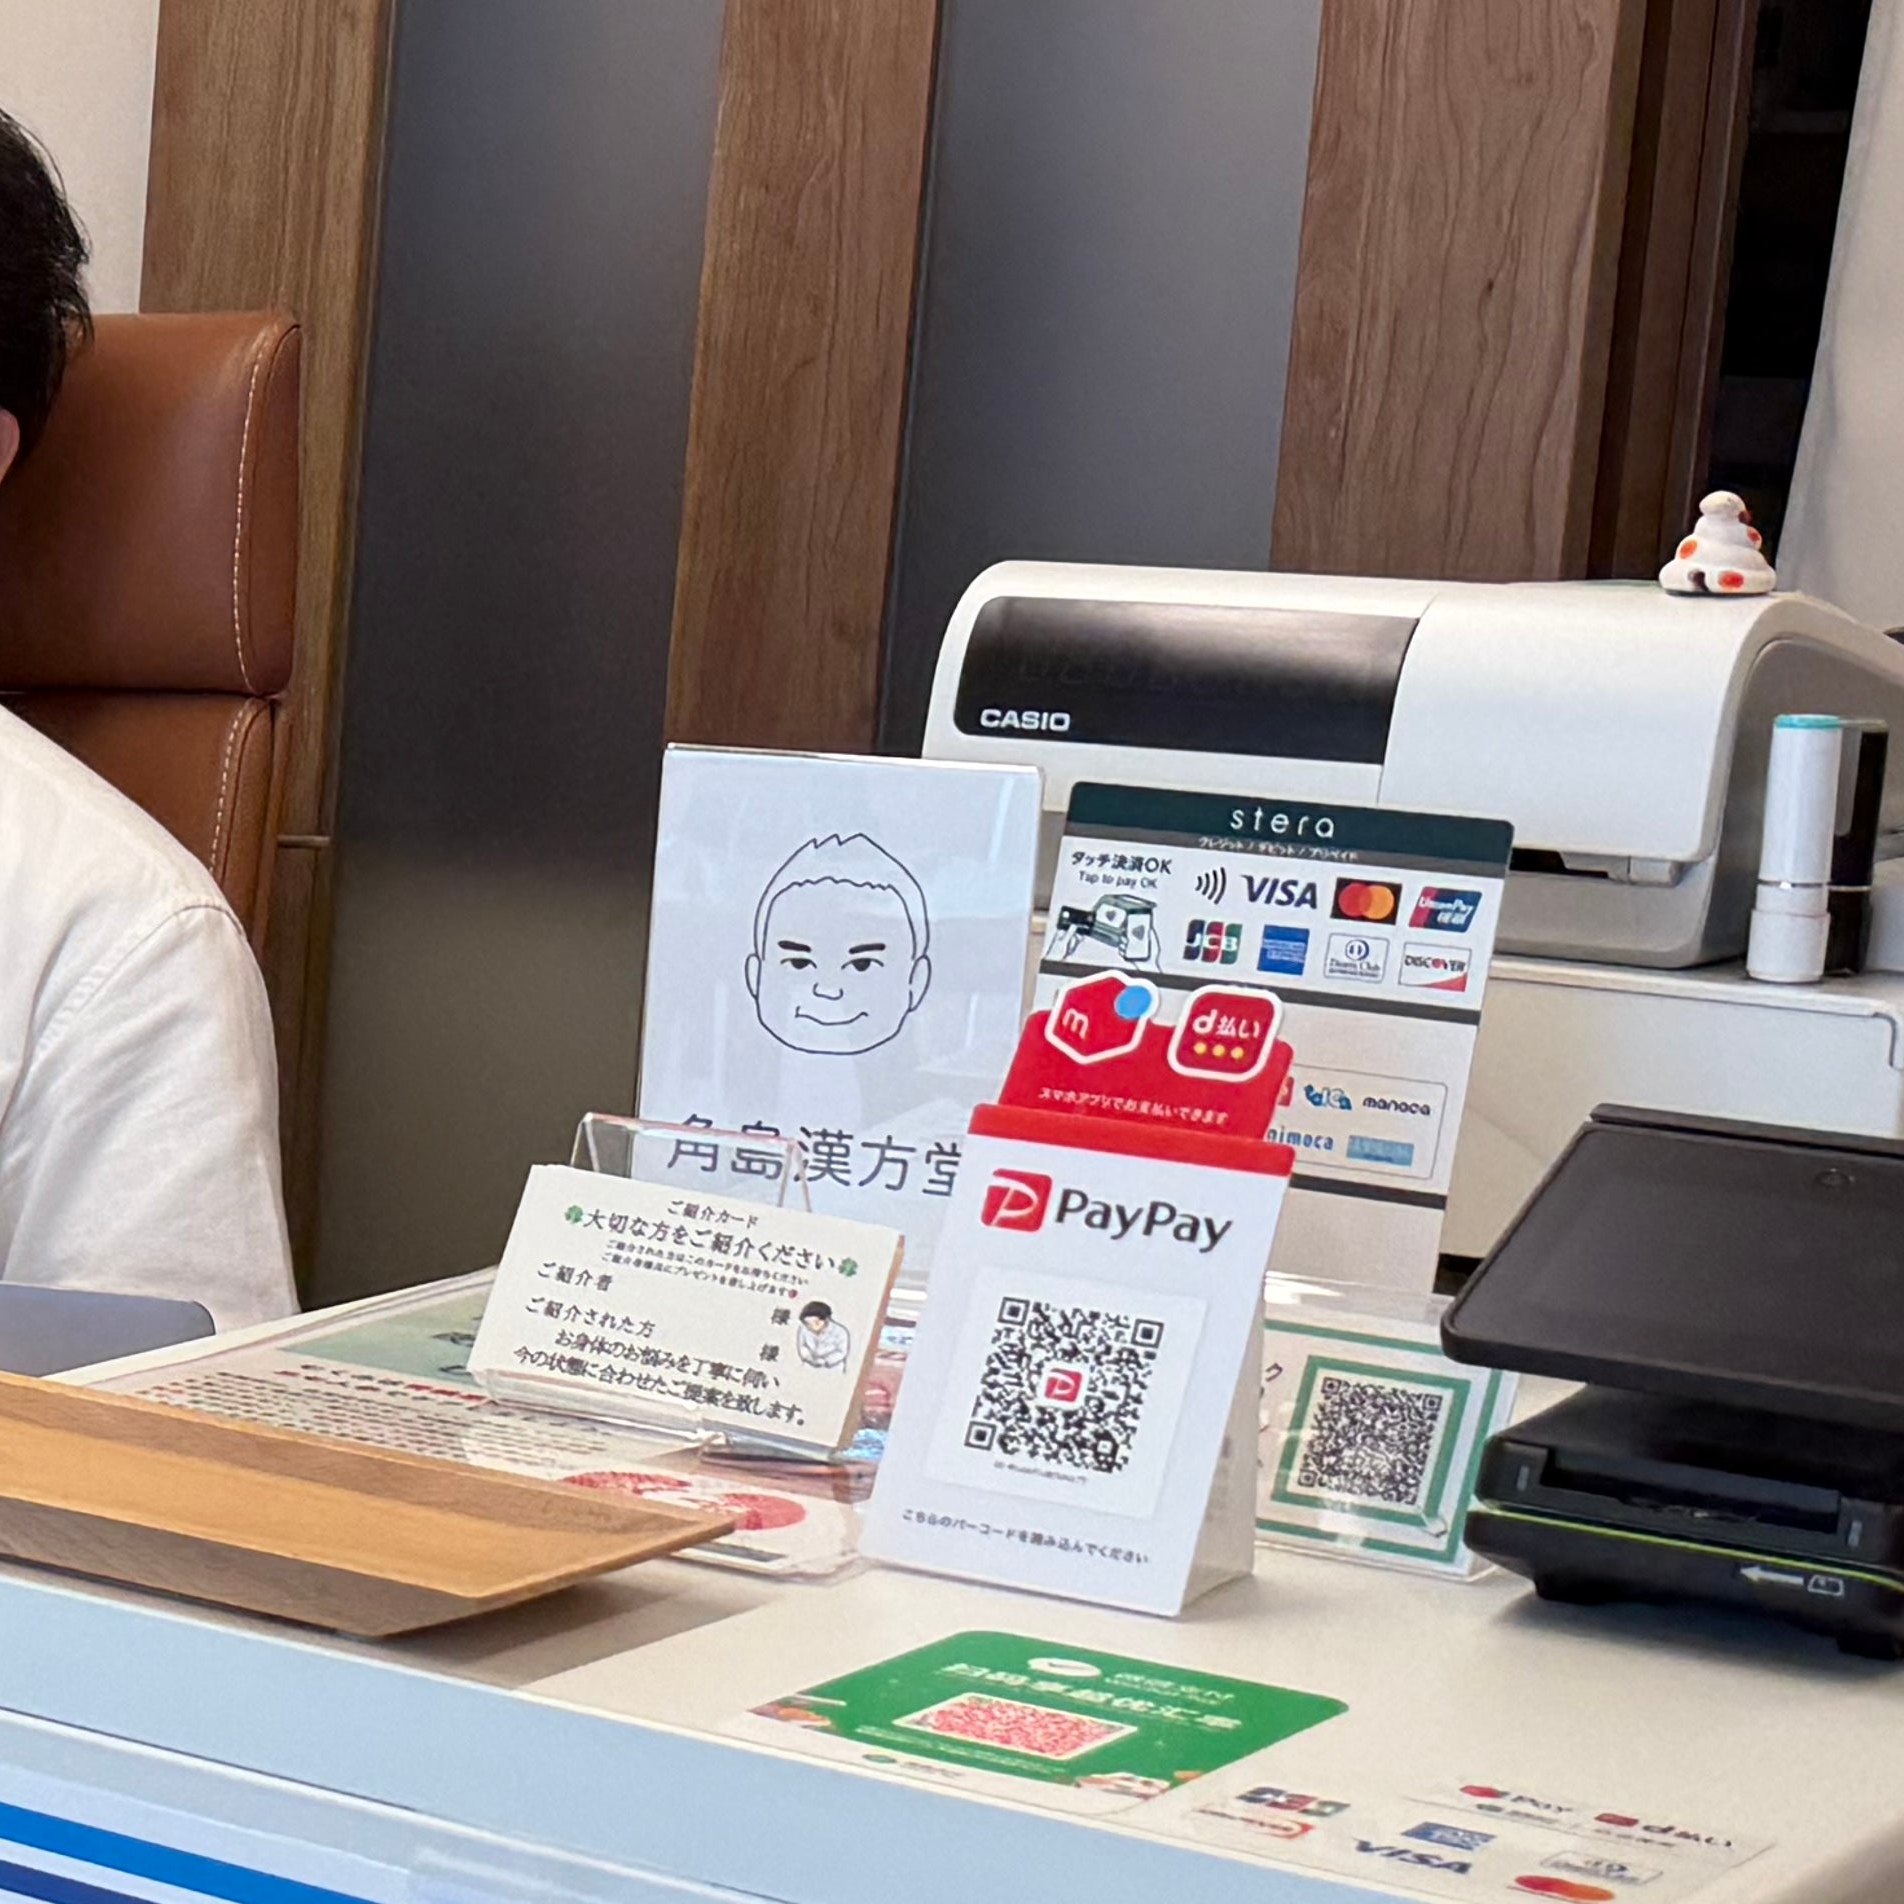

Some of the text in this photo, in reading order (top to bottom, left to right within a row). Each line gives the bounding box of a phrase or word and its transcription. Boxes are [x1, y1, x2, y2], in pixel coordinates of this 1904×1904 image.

[980, 708, 1070, 733] CASIO
[1230, 806, 1334, 839] stera
[1071, 851, 1172, 875] タッチ決済OK
[1140, 877, 1158, 890] OK
[1241, 874, 1318, 910] VISA
[1186, 934, 1239, 951] JCB
[1193, 1008, 1260, 1039] d払い
[1039, 1086, 1229, 1125] スマホアプリでお支払いできます
[667, 1114, 962, 1198] 角島漢方堂
[667, 1200, 759, 1229] ご紹介カード
[1055, 1188, 1233, 1254] PayPay
[583, 1208, 836, 1271] 大切な方をご紹介ください
[537, 1262, 791, 1327] ご紹介者 様
[525, 1296, 780, 1362] ご紹介された方 様
[554, 1327, 781, 1389] お身体のお悩みを丁寧に伺い
[514, 1345, 806, 1427] 今の状態に合わせたご提案を致します。
[902, 1508, 1150, 1564] こちらのバーコードを読み込んでください
